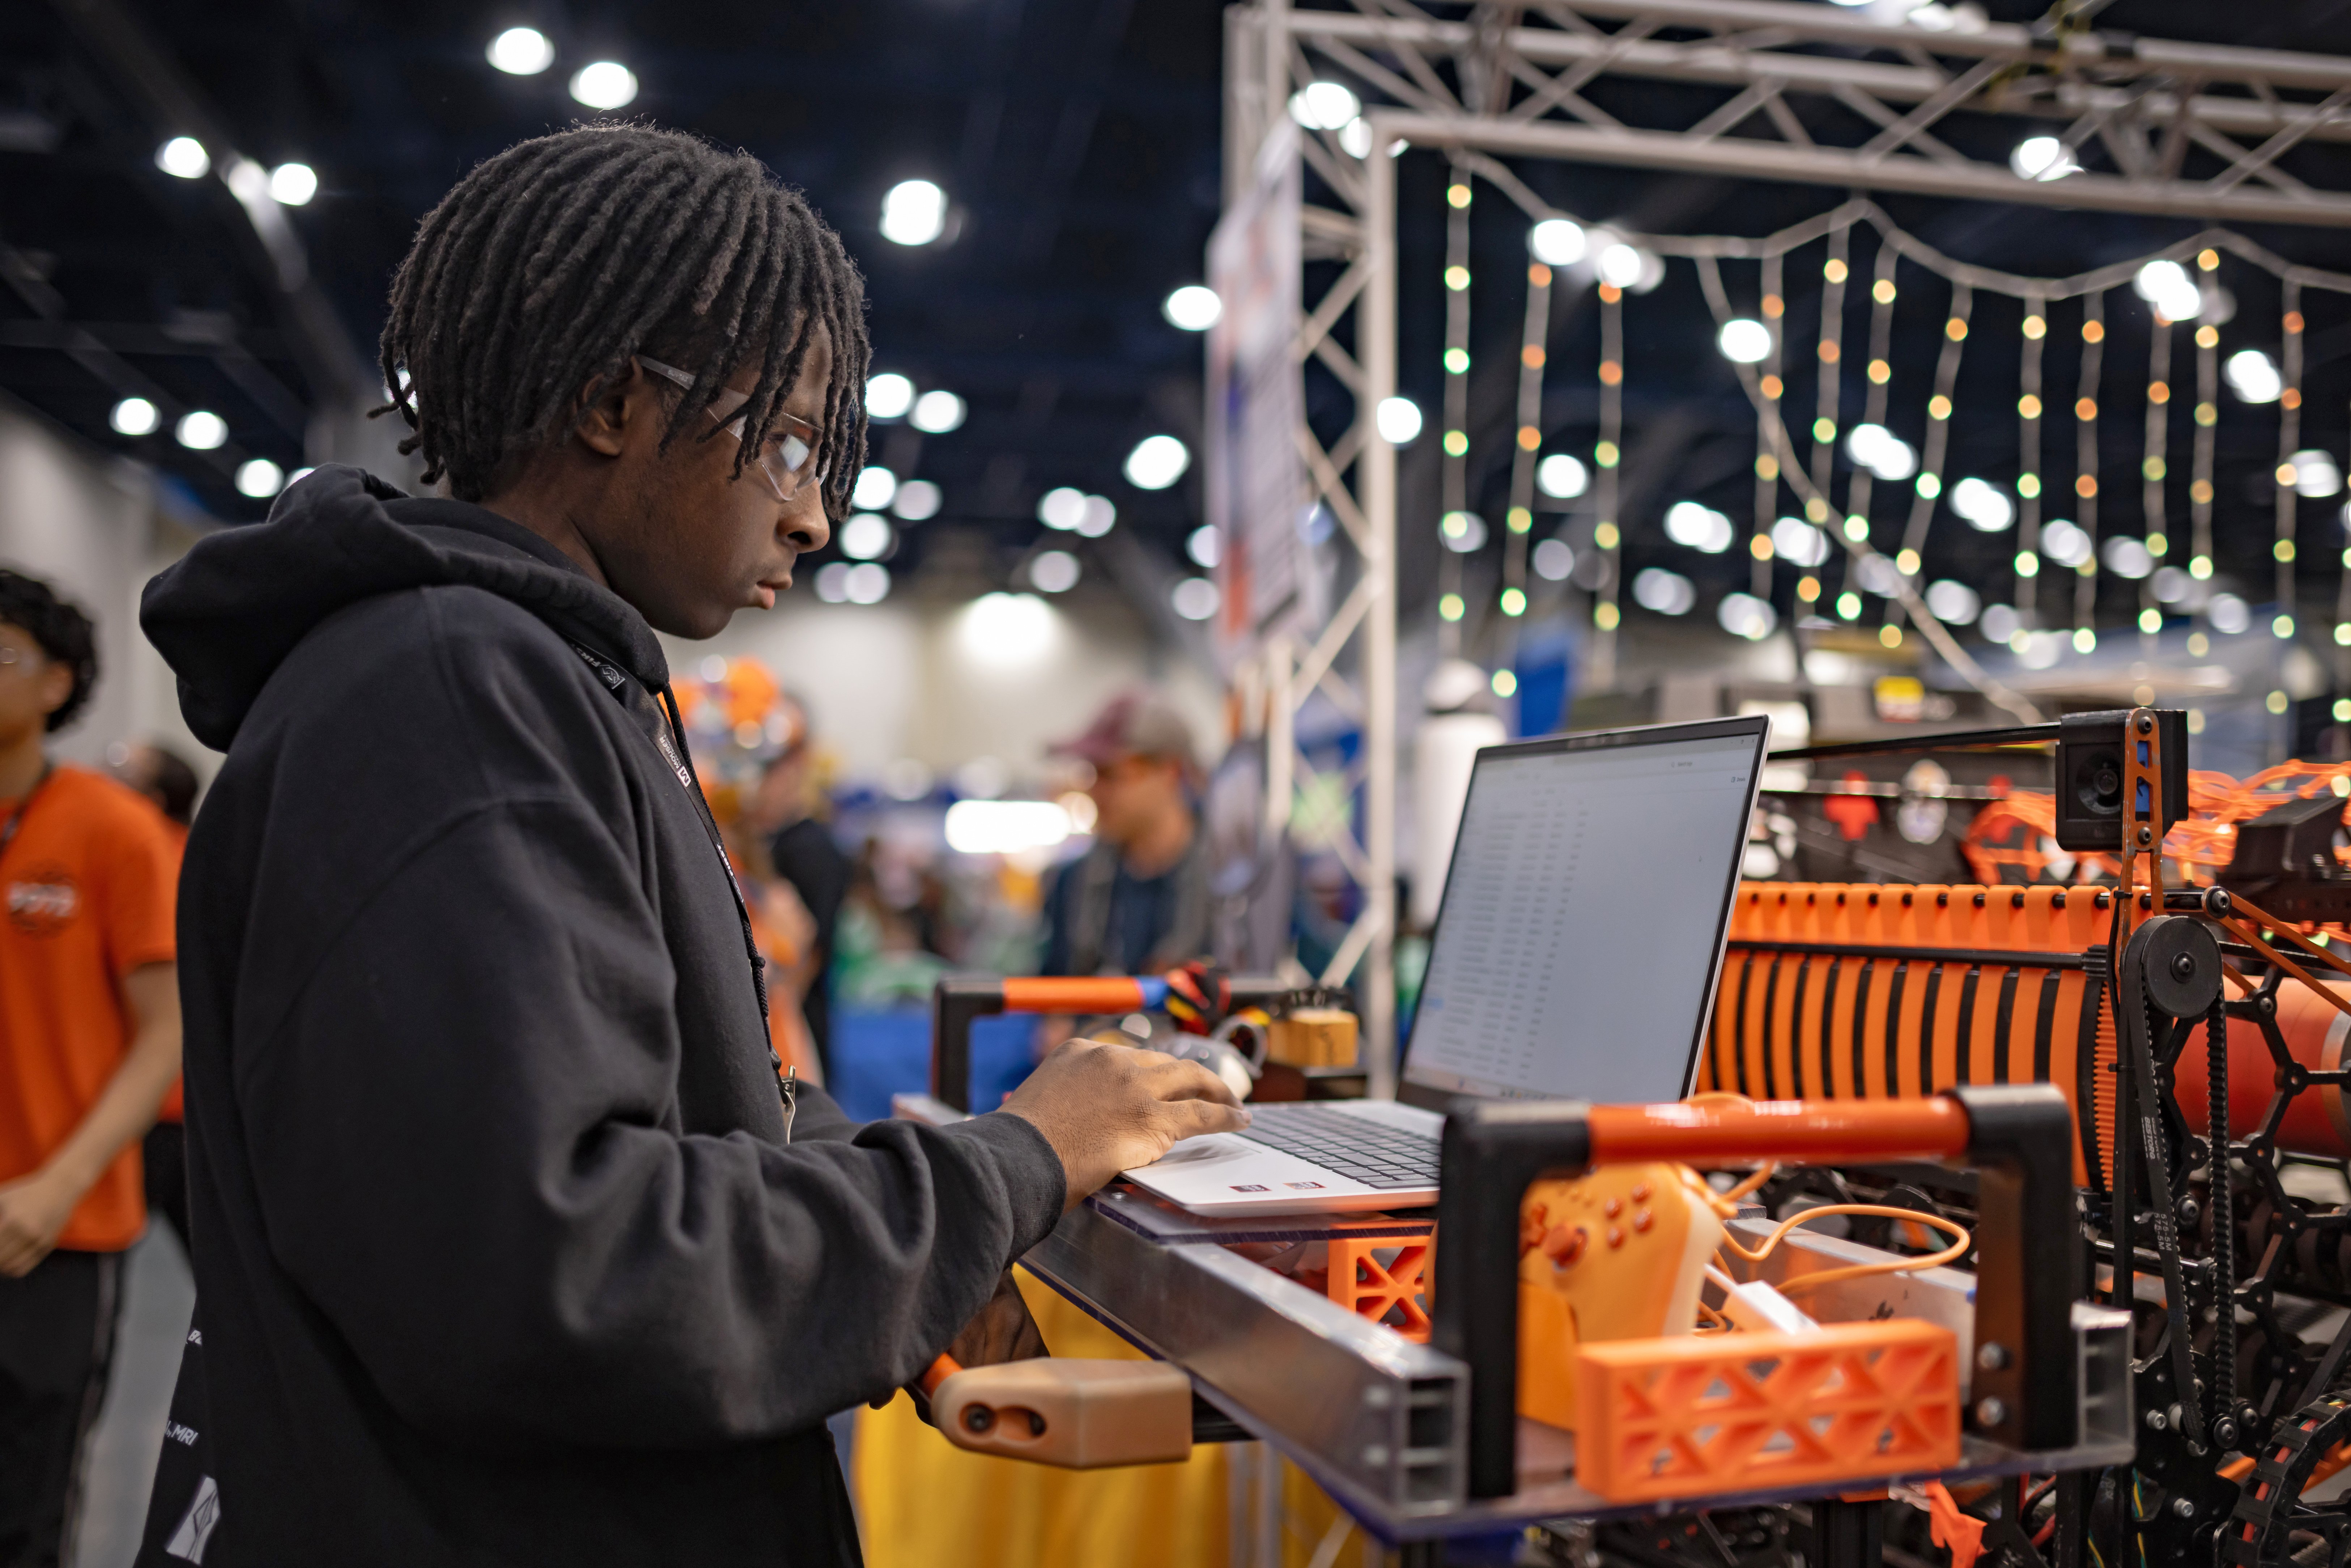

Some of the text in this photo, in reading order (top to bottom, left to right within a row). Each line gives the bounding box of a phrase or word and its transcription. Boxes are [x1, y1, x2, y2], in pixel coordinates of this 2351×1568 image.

[659, 736, 680, 769] MOUSER
[663, 734, 681, 766] ELECTRONICS
[717, 844, 734, 877] FIRST
[2144, 1116, 2156, 1160] BESTORQ
[2154, 1212, 2165, 1250] 575-5M
[2160, 1214, 2172, 1251] 575-5M
[171, 1424, 199, 1445] MRI
